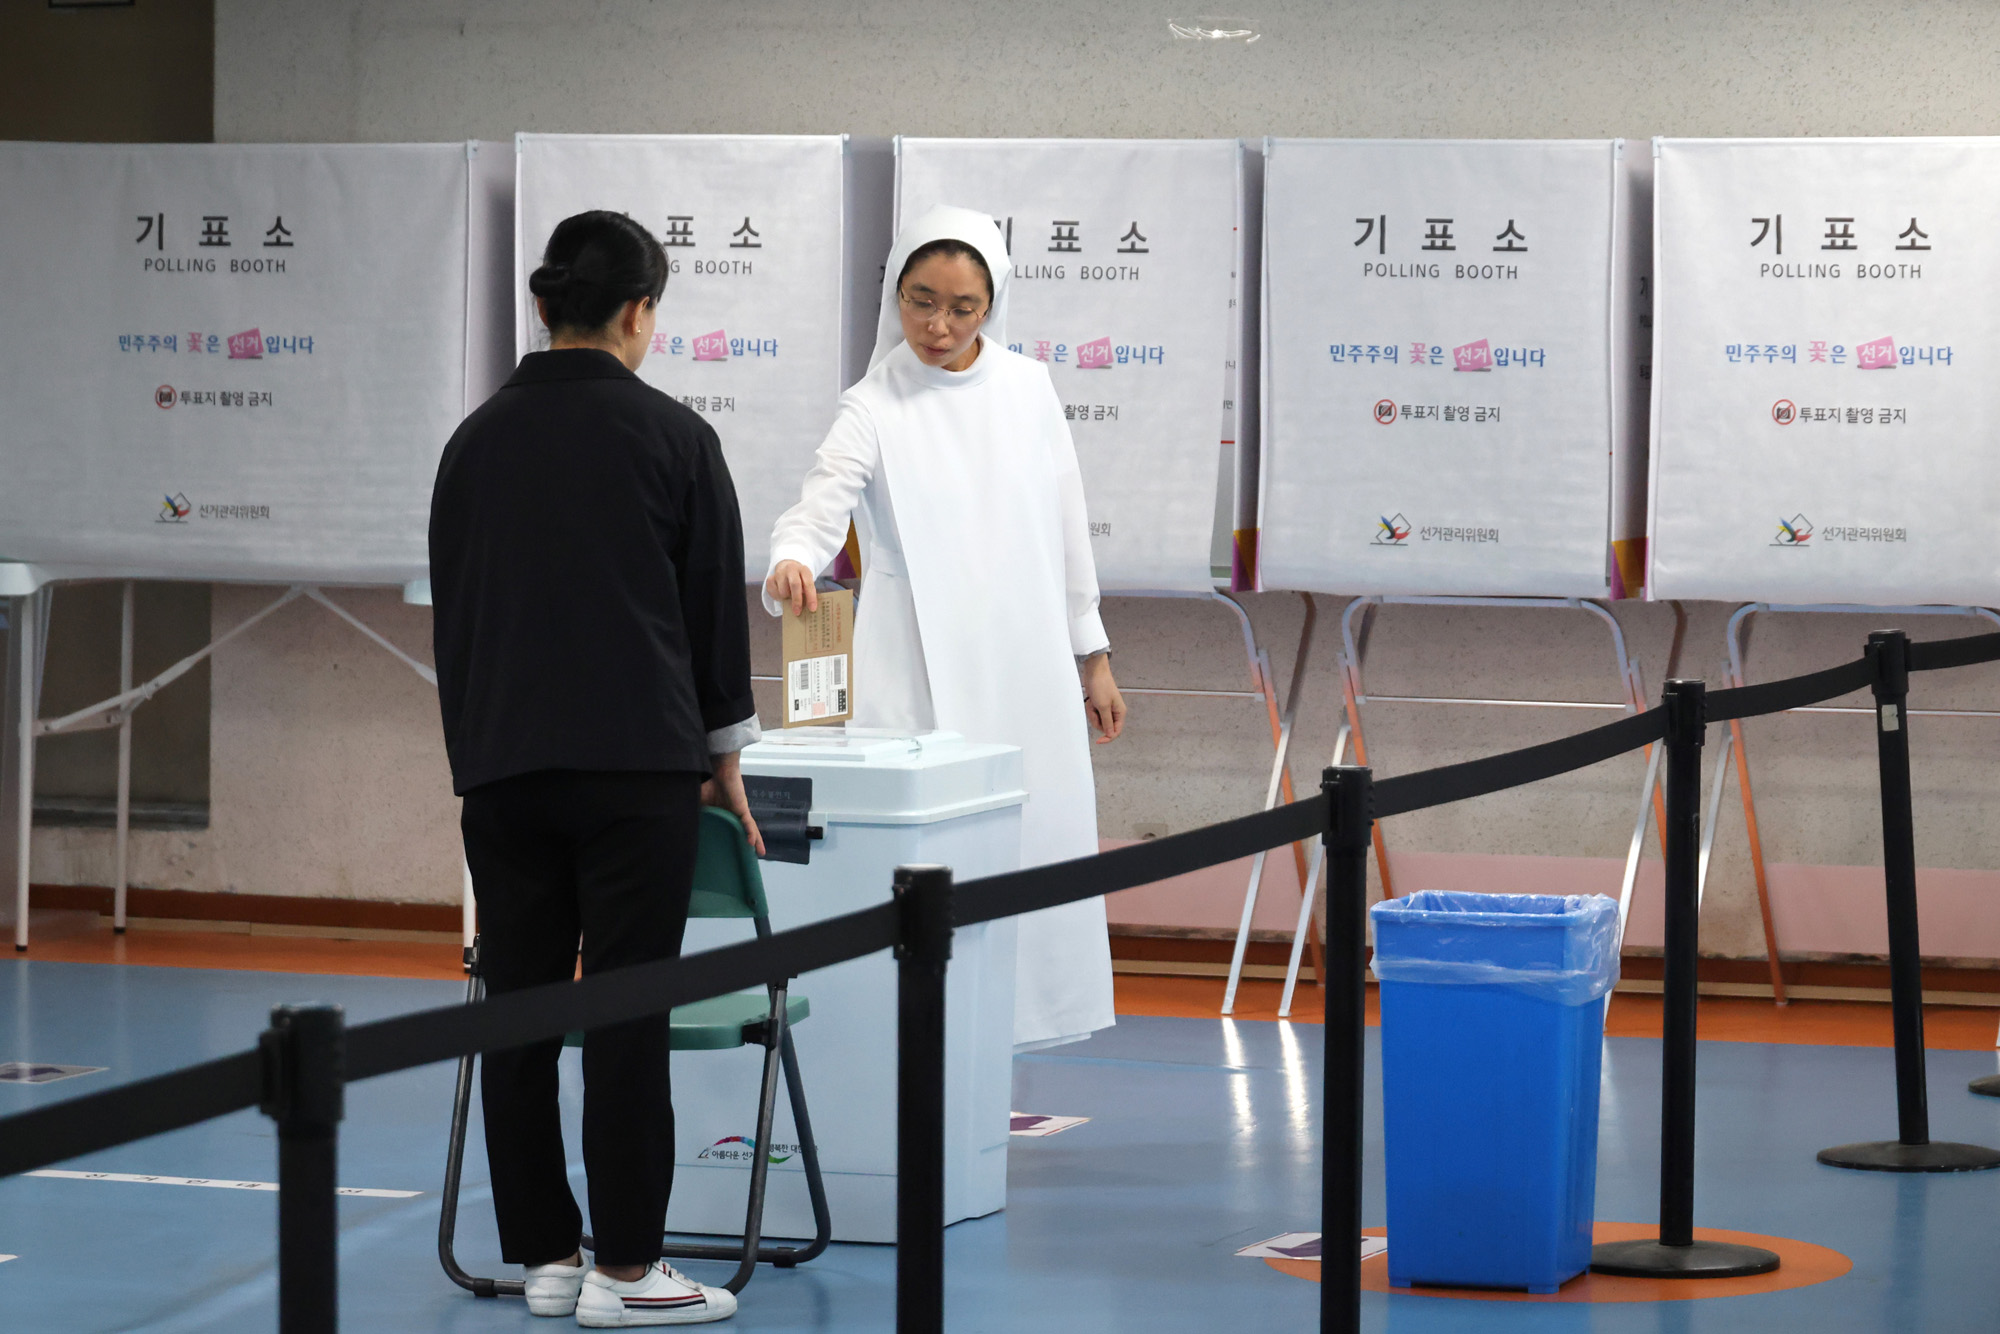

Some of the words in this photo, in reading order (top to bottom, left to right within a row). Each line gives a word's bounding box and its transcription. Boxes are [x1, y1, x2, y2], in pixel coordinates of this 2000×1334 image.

[144, 258, 217, 272] POLLING
[230, 259, 286, 272] BOOTH
[695, 261, 753, 274] BOOTH
[1014, 266, 1066, 279] LLING
[1081, 266, 1140, 280] BOOTH
[1364, 263, 1440, 278] POLLING
[1456, 265, 1518, 279] BOOTH
[1760, 264, 1841, 278] POLLING
[1857, 264, 1922, 279] BOOTH
[119, 335, 177, 353] 민주주의
[1330, 344, 1399, 364] 민주주의
[1725, 344, 1797, 363] 민주주의
[179, 391, 216, 406] 투표지
[220, 391, 244, 406] 촬영
[248, 391, 273, 406] 금지
[711, 396, 735, 412] 금지
[1064, 404, 1089, 420] 촬영
[1094, 404, 1118, 420] 금지
[1400, 405, 1439, 420] 투표지
[1444, 406, 1470, 421] 촬영
[1474, 407, 1501, 422] 금지
[1799, 407, 1841, 423] 투표지
[1846, 407, 1874, 423] 촬영
[1878, 408, 1906, 424] 금지
[199, 504, 270, 519] 선거관리위원회
[1420, 527, 1499, 543] 선거관리위원회
[1822, 527, 1907, 542] 선거관리위원회
[712, 1150, 739, 1160] 아름다운
